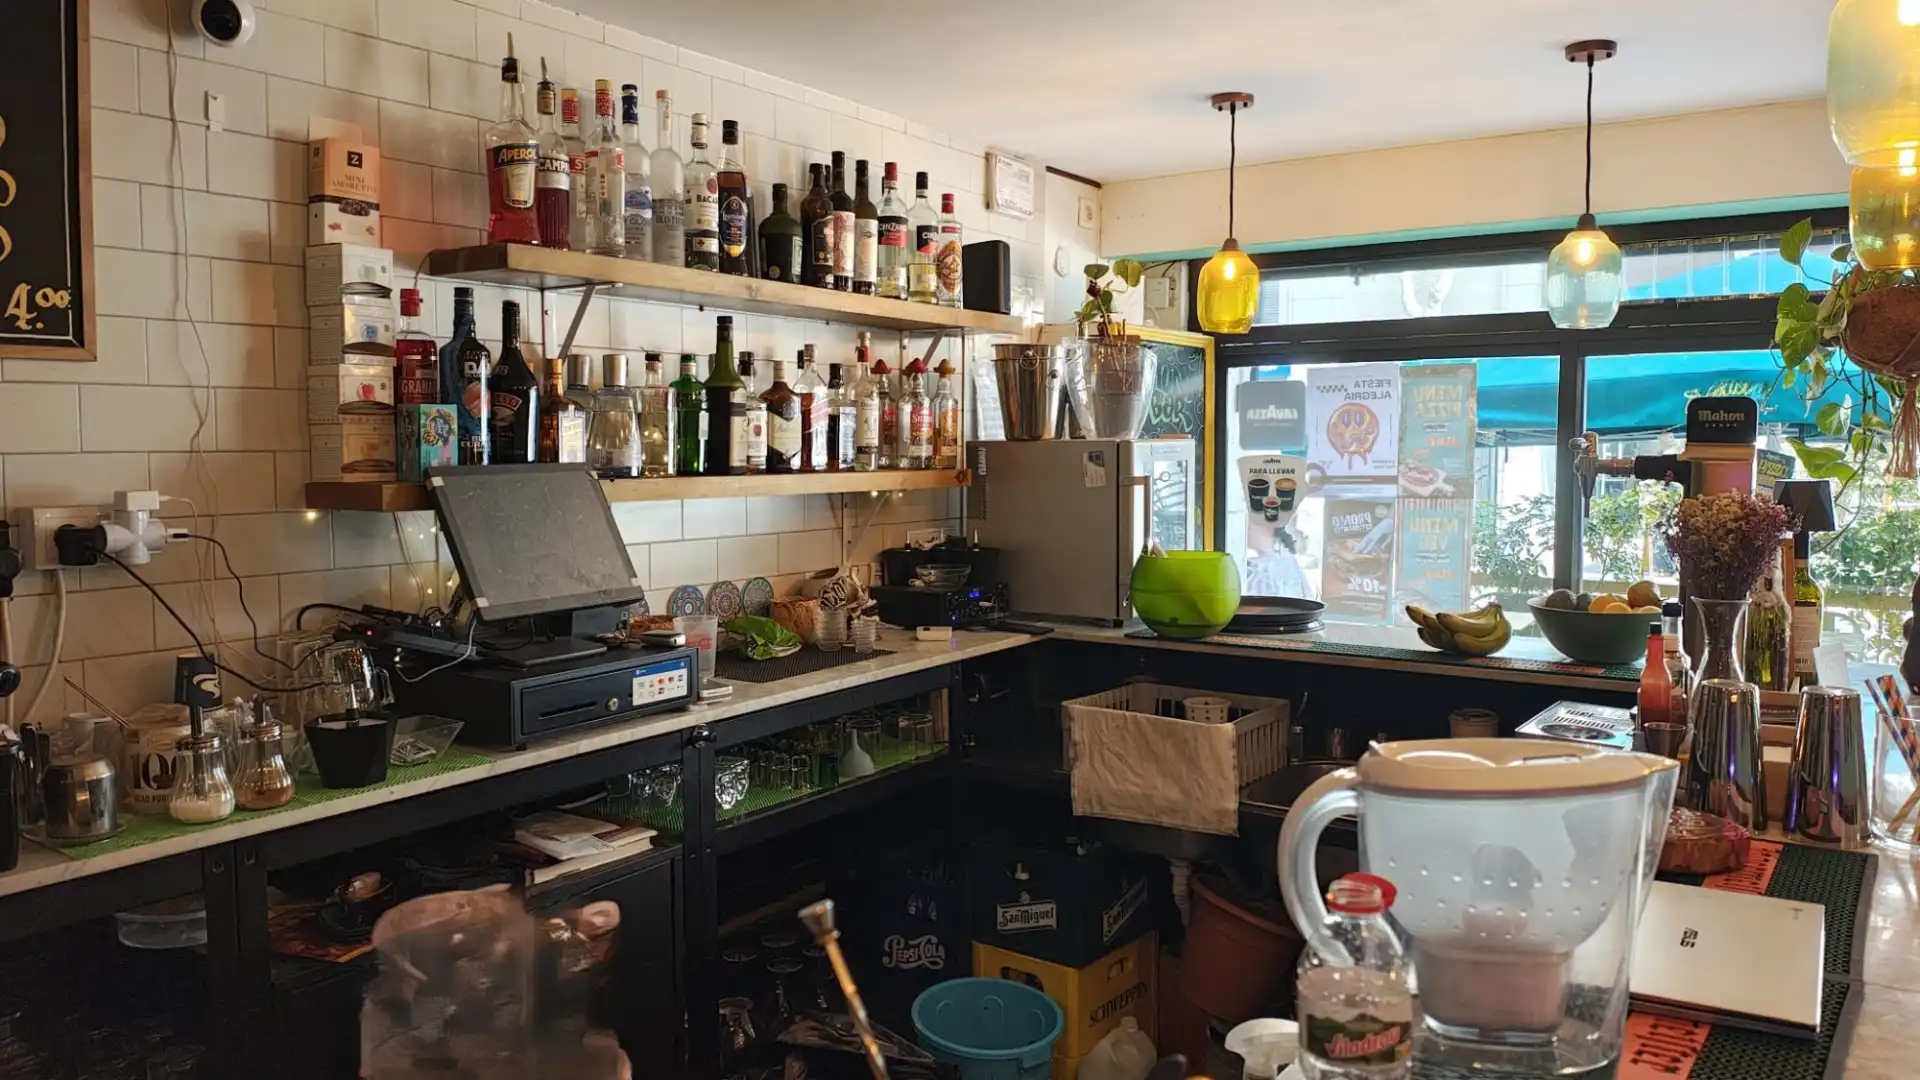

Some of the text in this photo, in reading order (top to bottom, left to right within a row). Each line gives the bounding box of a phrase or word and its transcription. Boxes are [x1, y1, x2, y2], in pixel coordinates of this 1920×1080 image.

[350, 154, 360, 165] Z
[499, 147, 537, 163] APEROL
[1698, 409, 1746, 422] Mahou
